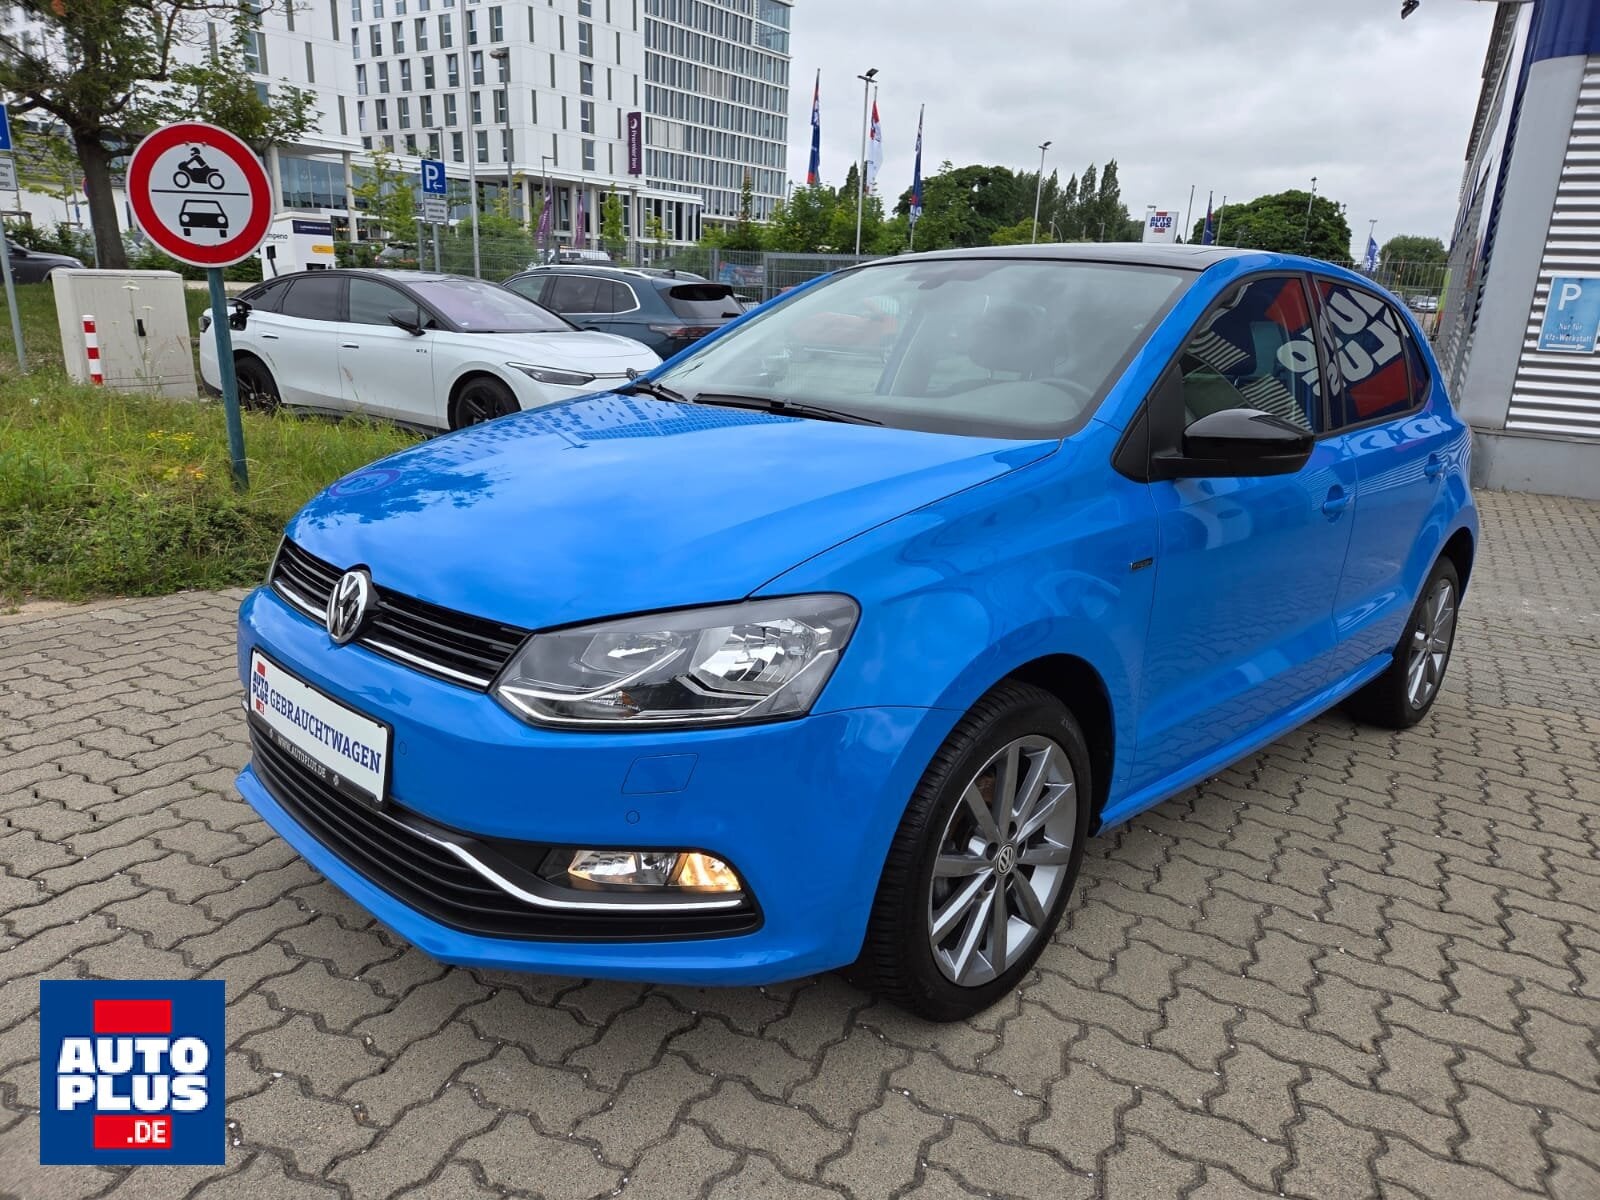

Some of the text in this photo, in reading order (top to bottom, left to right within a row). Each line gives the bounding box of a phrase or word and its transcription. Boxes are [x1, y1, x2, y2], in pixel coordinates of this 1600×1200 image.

[425, 165, 439, 189] P
[1558, 283, 1582, 311] P
[1545, 333, 1593, 342] Kfz-Werkstatt
[1572, 322, 1583, 330] für
[253, 671, 269, 692] AUTO
[253, 681, 269, 705] PLUS
[270, 688, 382, 774] GEBRAUCHTWAGEN
